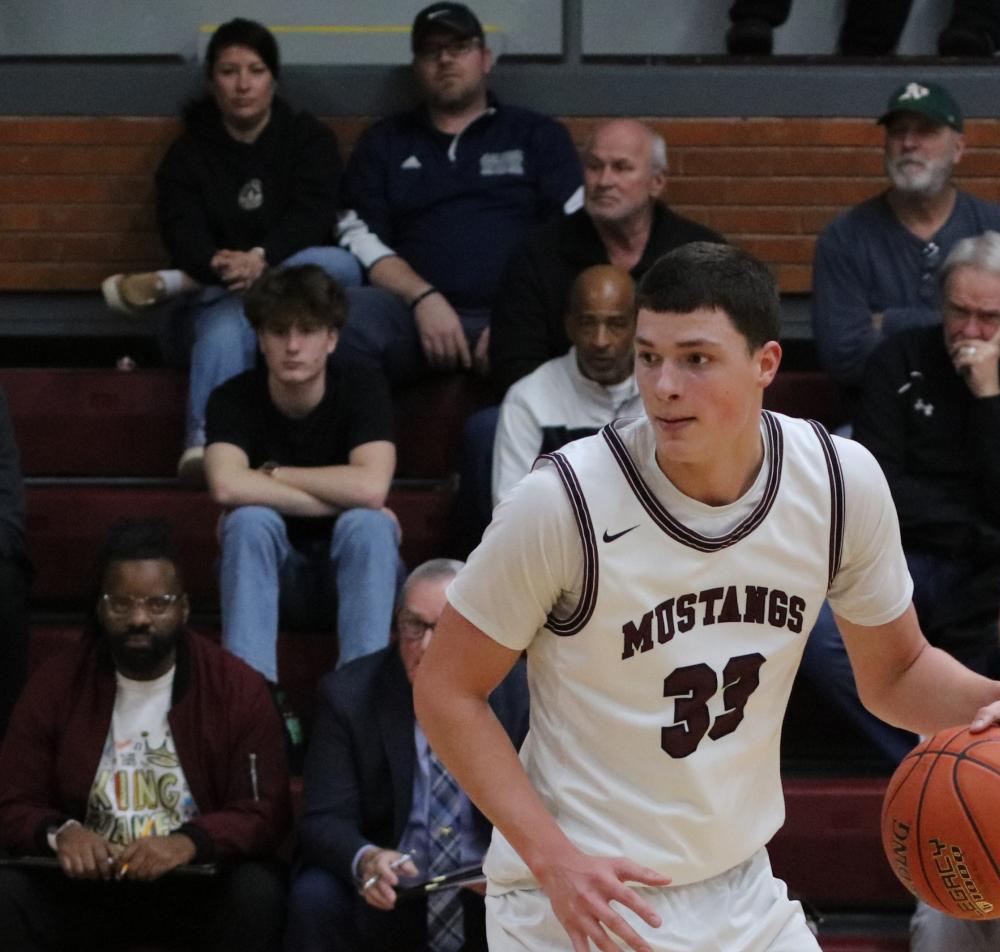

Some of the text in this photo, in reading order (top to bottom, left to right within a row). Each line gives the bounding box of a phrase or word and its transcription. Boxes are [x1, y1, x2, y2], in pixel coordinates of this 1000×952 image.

[622, 585, 806, 660] MUSTANGS
[661, 652, 767, 759] 33
[90, 768, 181, 813] KING
[928, 837, 976, 912] EGACY
